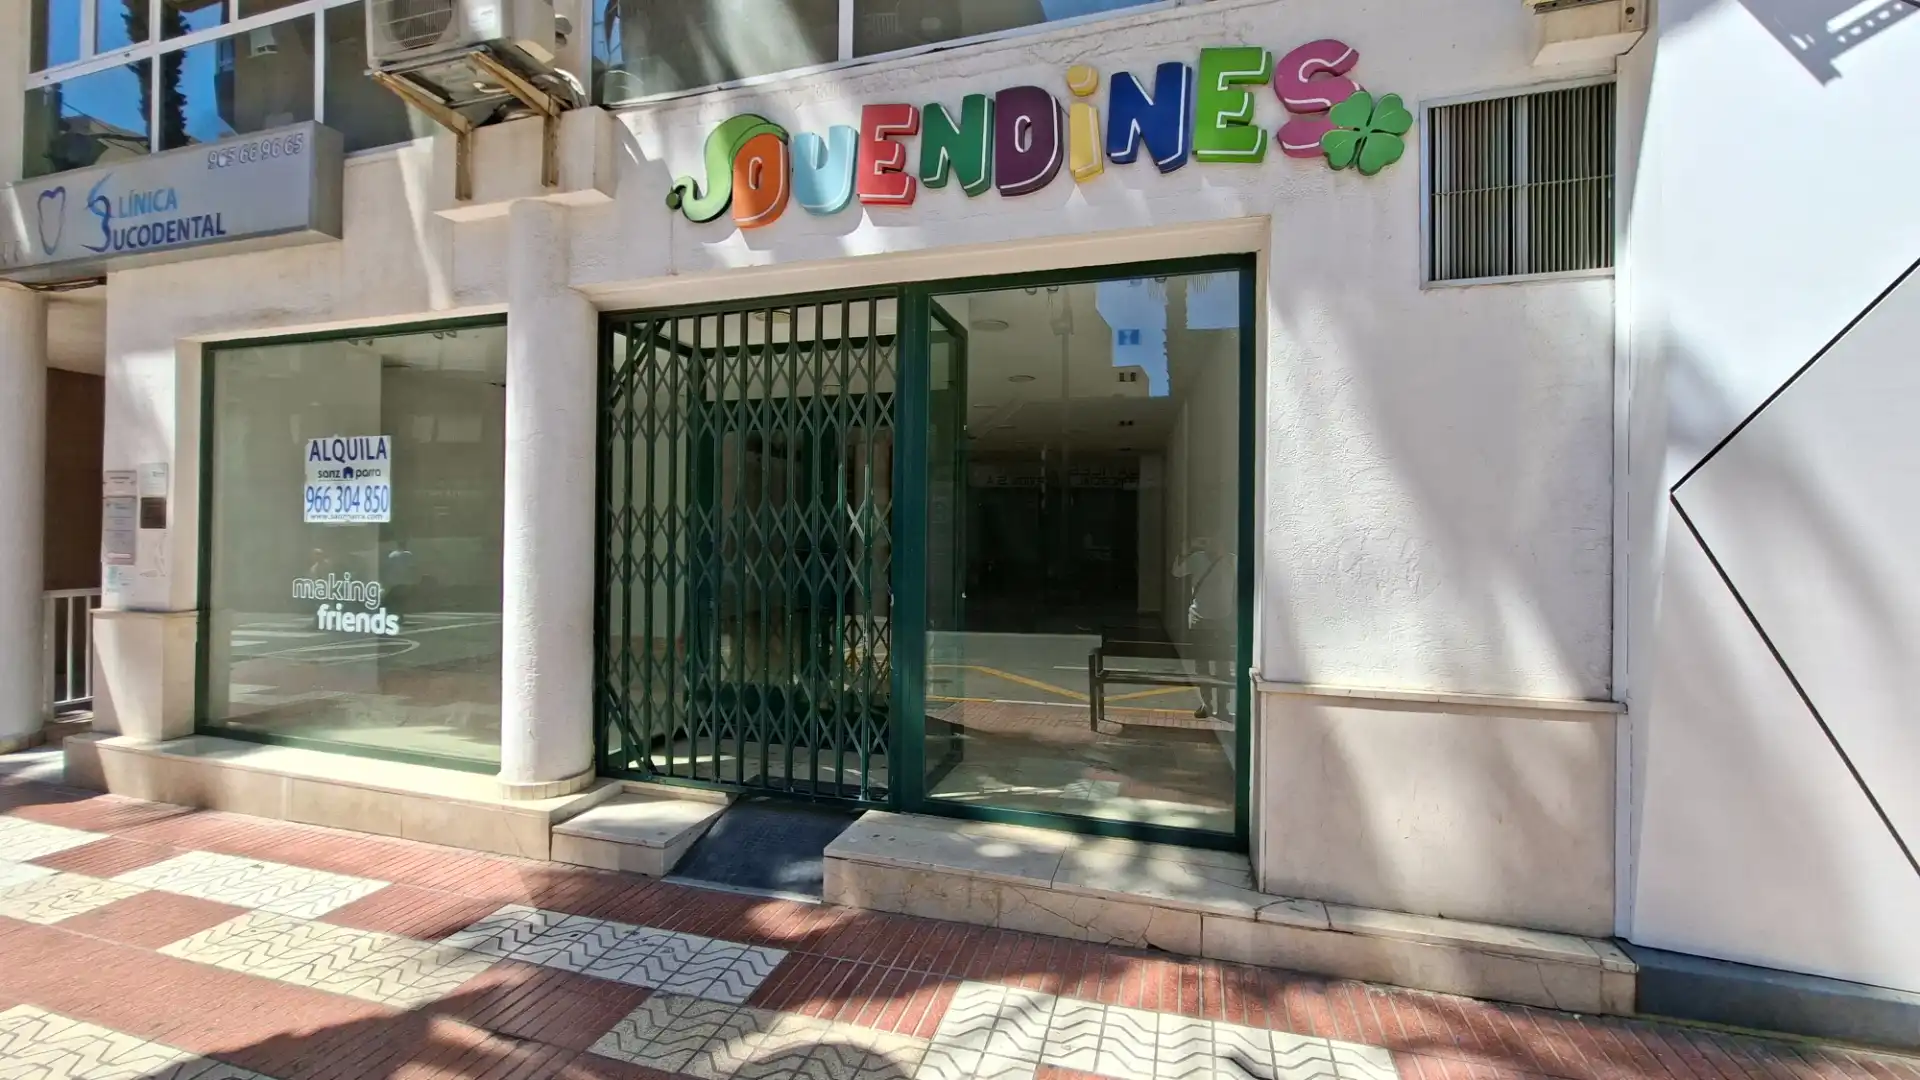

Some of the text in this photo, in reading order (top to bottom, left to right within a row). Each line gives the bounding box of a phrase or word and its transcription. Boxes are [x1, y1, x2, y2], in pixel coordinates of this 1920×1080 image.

[207, 147, 237, 170] 965
[261, 138, 282, 160] 96
[282, 133, 304, 156] 65
[309, 437, 387, 463] ALQUILA
[318, 468, 381, 480] sanz parra
[306, 485, 389, 513] 966 304 850
[292, 572, 381, 610] making
[317, 603, 399, 635] friends
